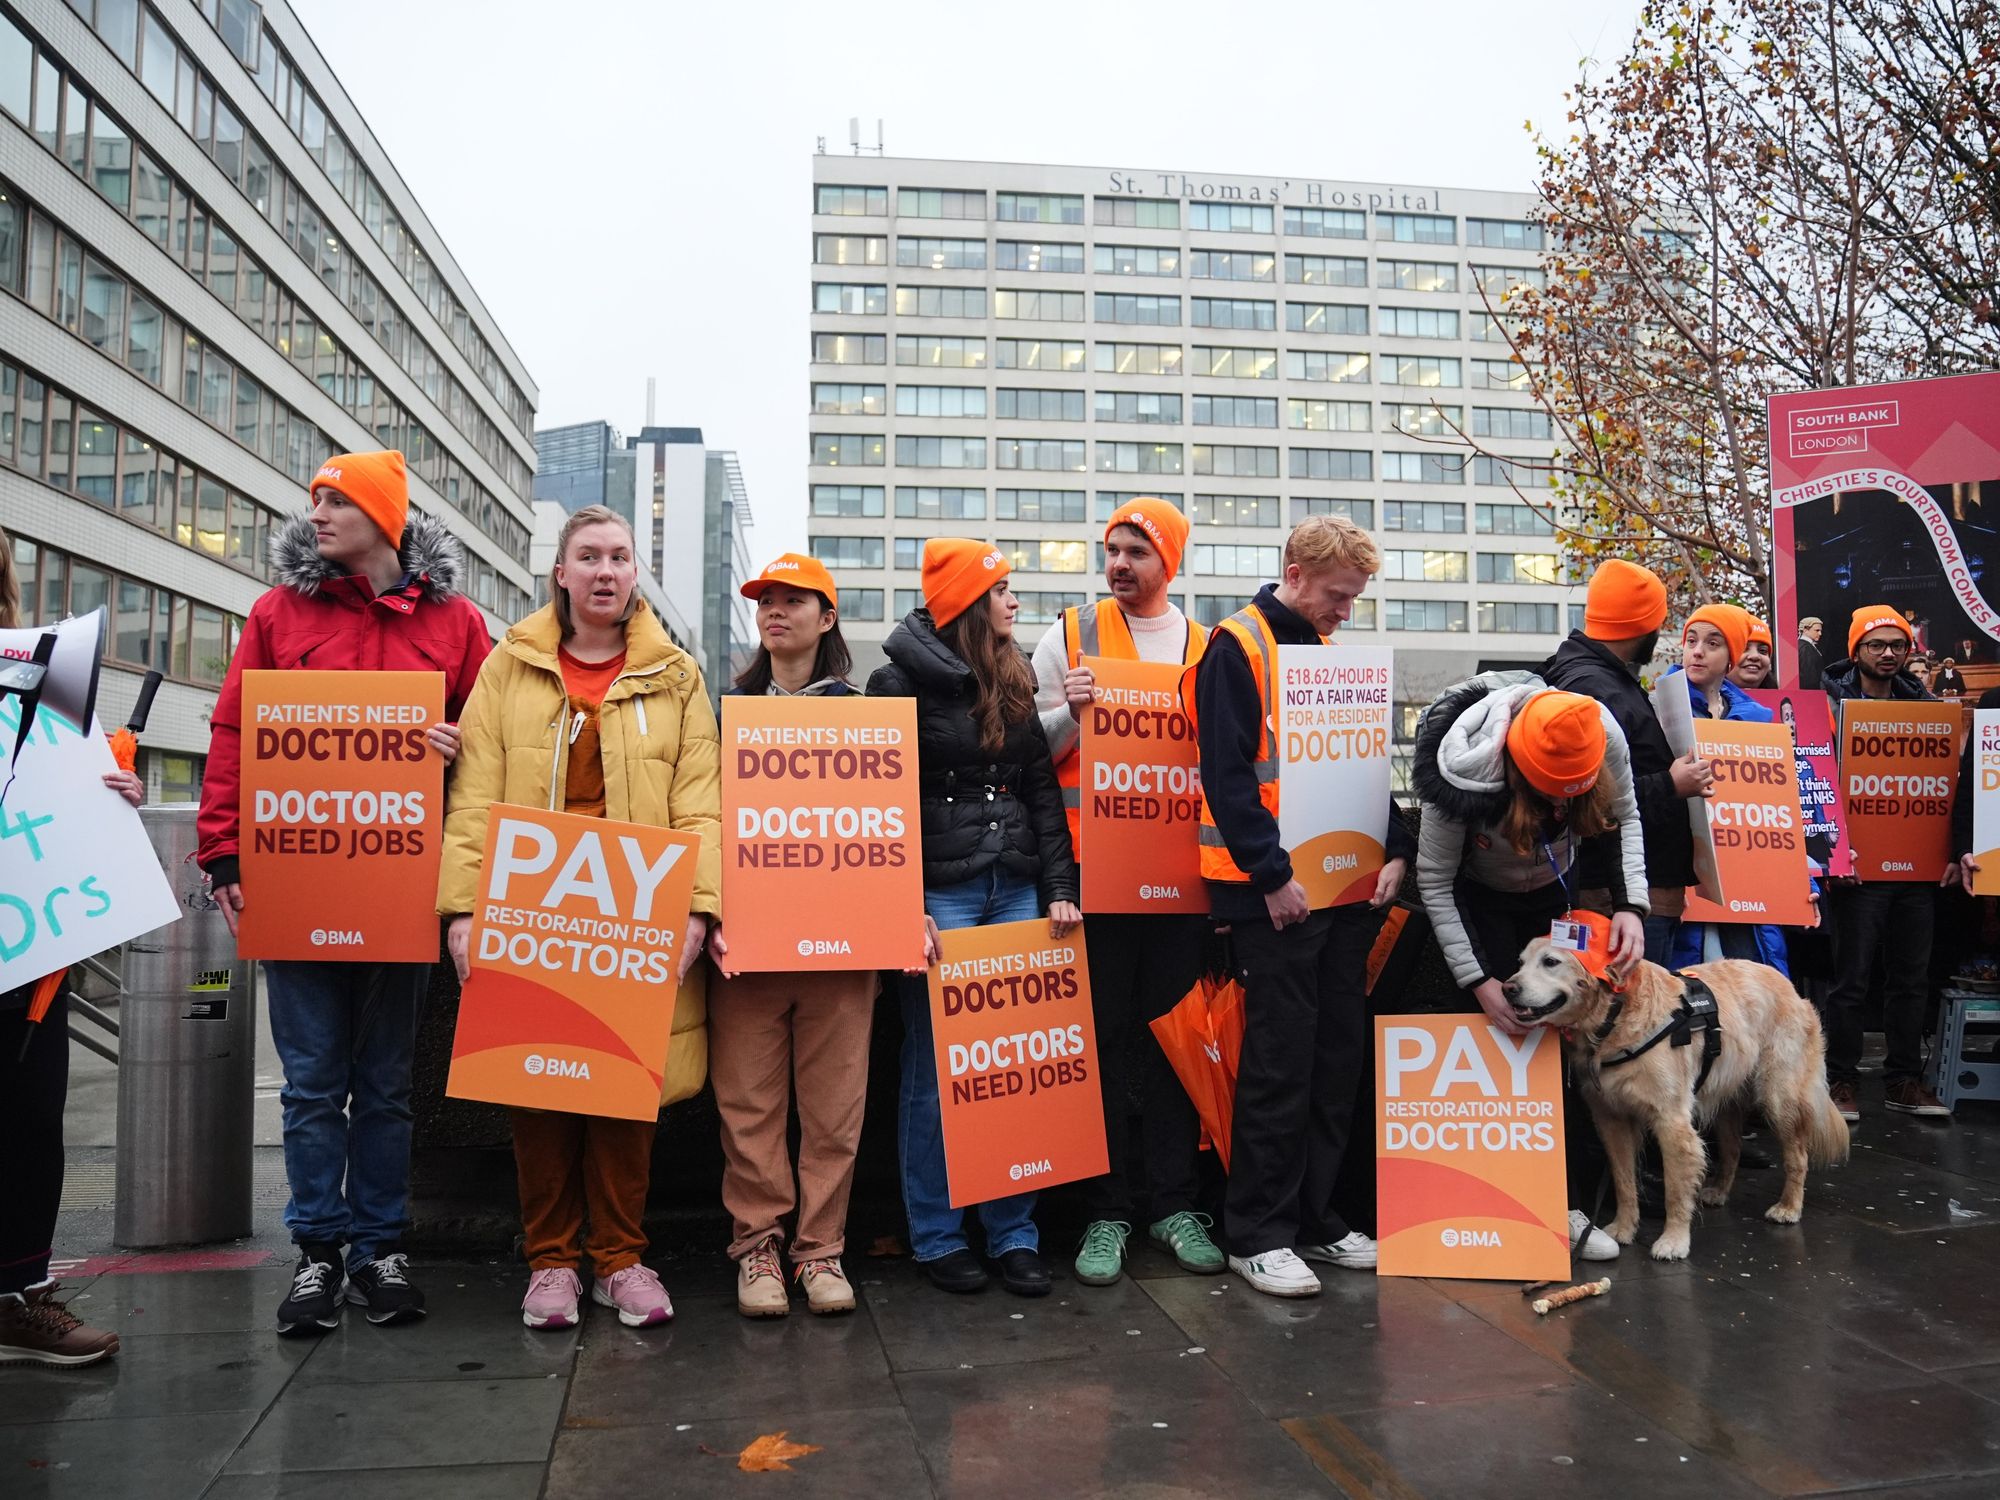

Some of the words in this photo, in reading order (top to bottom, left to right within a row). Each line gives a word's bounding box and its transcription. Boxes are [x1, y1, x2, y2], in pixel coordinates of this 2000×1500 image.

[1109, 171, 1143, 195] St.
[1157, 174, 1289, 202] Thomas'
[1307, 183, 1442, 215] Hospital
[1796, 414, 1844, 428] SOUTH
[1849, 409, 1889, 423] BANK
[1798, 434, 1858, 451] LONDON
[1143, 520, 1164, 545] BMA
[1779, 471, 1878, 502] CHRISTIE'S
[1883, 474, 1959, 565] COURTROOM
[1951, 567, 1992, 624] COMES
[776, 561, 800, 570] BMA
[1753, 624, 1766, 633] MA
[1874, 617, 1898, 626] BMA
[1286, 667, 1373, 685] £18.62/HOUR
[1376, 668, 1387, 684] IS
[1094, 687, 1172, 709] PATIENTS
[1287, 690, 1313, 706] NOT
[1316, 690, 1325, 705] A
[1328, 689, 1353, 705] FAIR
[1356, 689, 1387, 704] WAGE
[257, 704, 360, 723] PATIENTS
[366, 705, 427, 724] NEED
[1094, 707, 1197, 741] DOCTO
[1287, 710, 1313, 727] FOR
[1317, 710, 1326, 725] A
[1329, 708, 1387, 725] RESIDENT
[737, 727, 838, 746] PATIENTS
[843, 727, 901, 745] NEED
[1852, 721, 1913, 734] PATIENTS
[1916, 722, 1952, 735] NEED
[1982, 725, 2000, 737] £1
[257, 727, 427, 761] DOCTORS
[1287, 728, 1387, 763] DOCTOR
[1744, 745, 1784, 759] NEED
[1851, 736, 1951, 758] DOCTORS
[1982, 740, 2000, 751] NO
[737, 749, 903, 780] DOCTORS
[1982, 754, 2000, 766] FO
[1094, 761, 1201, 795] DOCTOR
[1710, 758, 1787, 785] CTORS
[1982, 768, 2000, 791] D
[1805, 777, 1831, 790] think
[1850, 775, 1950, 797] DOCTORS
[256, 790, 426, 824] DOCTORS
[1813, 791, 1835, 804] NHS
[1094, 796, 1161, 820] NEED
[1165, 798, 1203, 824] JOB
[1848, 799, 1899, 815] NEED
[1904, 799, 1948, 818] JOBS
[737, 806, 906, 839] DOCTORS
[254, 828, 340, 854] NEED
[346, 829, 425, 860] JOBS
[1714, 828, 1741, 847] ED
[1746, 830, 1796, 850] JOBS
[737, 843, 824, 868] NEED
[830, 843, 906, 872] JOBS
[1335, 853, 1358, 871] BMA
[1892, 862, 1914, 871] BMA
[487, 817, 687, 922] PAY
[1153, 886, 1180, 899] BMA
[1741, 901, 1766, 912] BMA
[484, 904, 629, 940] RESTORATION
[633, 927, 674, 947] FOR
[328, 930, 364, 945] BMA
[815, 940, 852, 955] BMA
[478, 927, 671, 984] DOCTORS
[940, 954, 1025, 981] PATIENTS
[1029, 947, 1075, 968] NEED
[942, 967, 1079, 1017] DOCTORS
[948, 1024, 1085, 1076] DOCTORS
[546, 1059, 590, 1080] BMA
[1384, 1025, 1547, 1097] PAY
[952, 1071, 1023, 1105] NEED
[1029, 1058, 1087, 1095] JOBS
[1385, 1102, 1511, 1117] RESTORATION
[1516, 1102, 1553, 1117] FOR
[1386, 1122, 1555, 1151] DOCTORS
[1023, 1159, 1052, 1177] BMA
[1461, 1231, 1502, 1247] BMA
